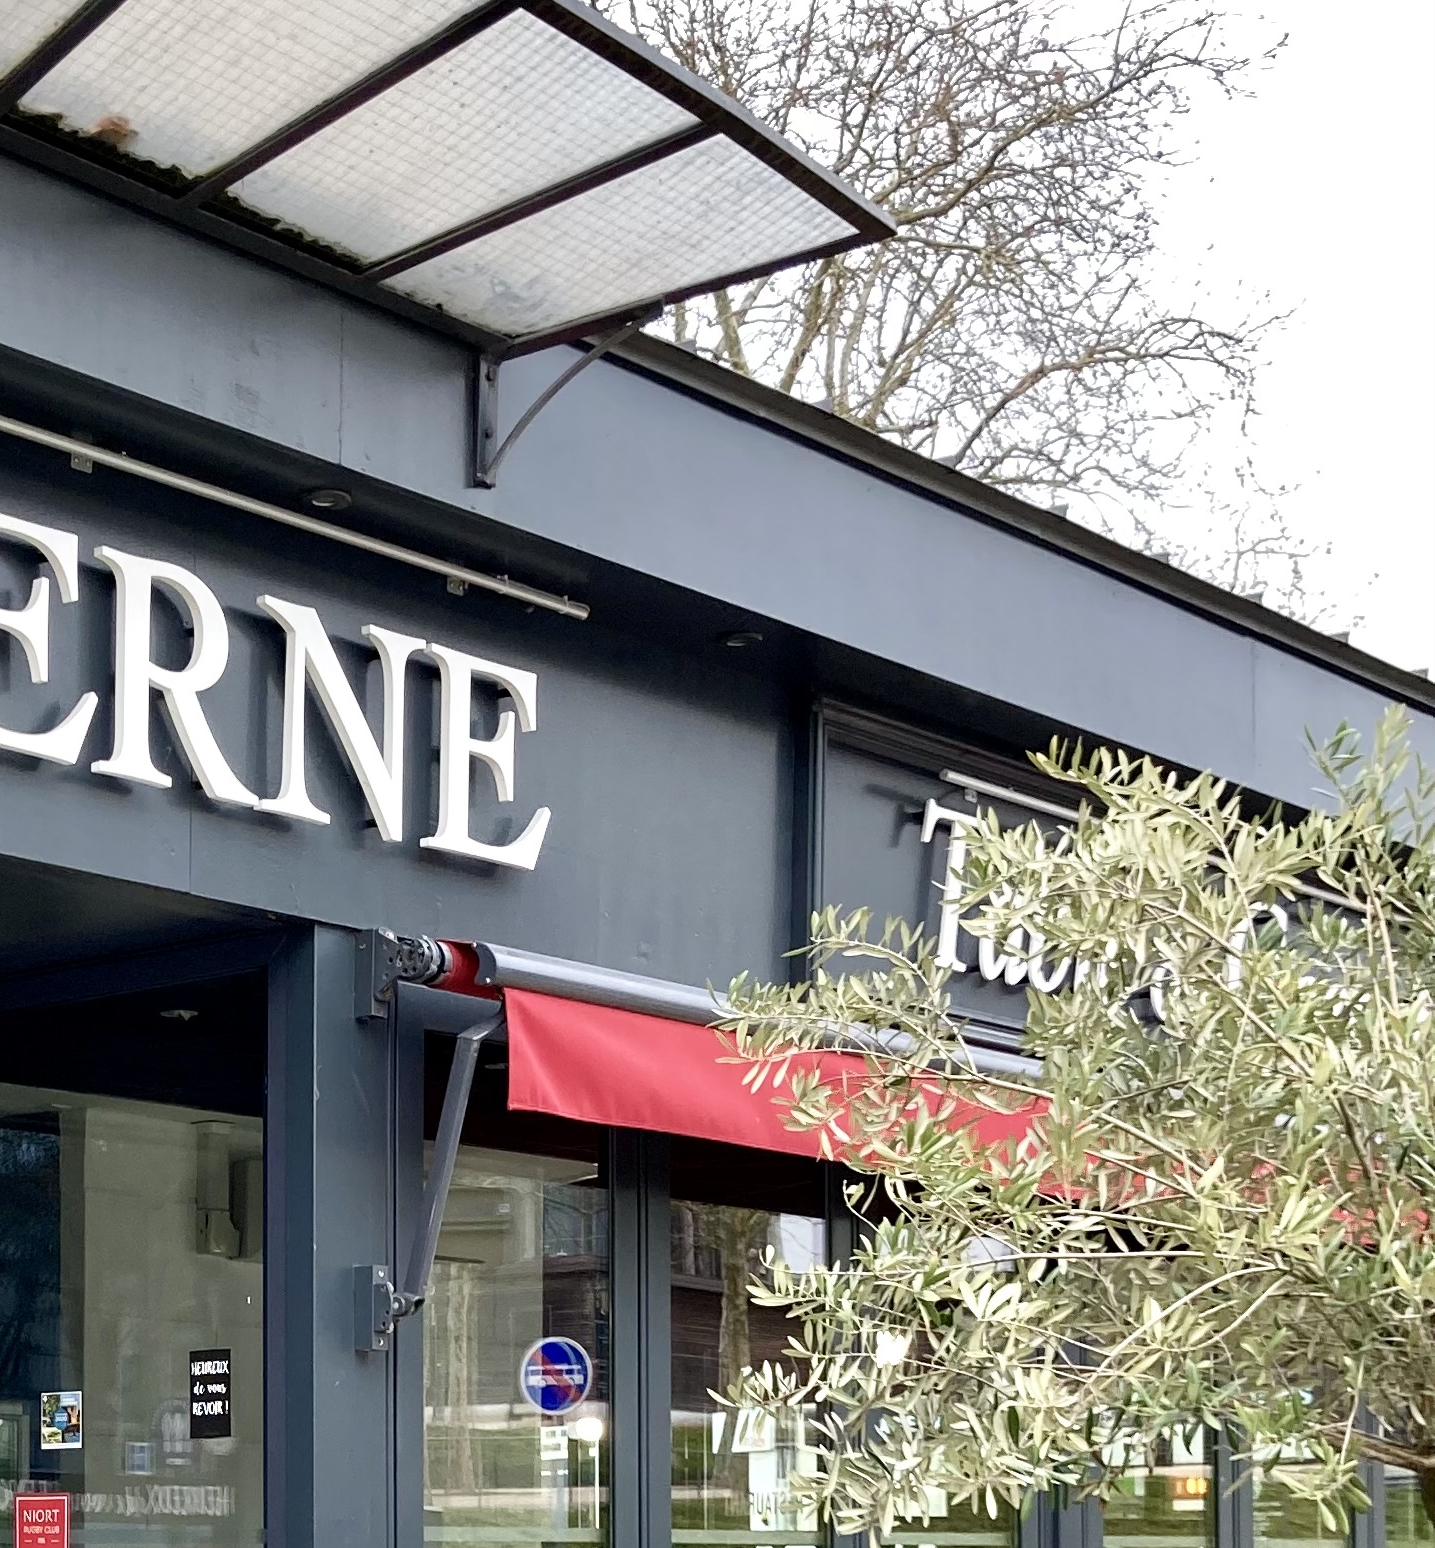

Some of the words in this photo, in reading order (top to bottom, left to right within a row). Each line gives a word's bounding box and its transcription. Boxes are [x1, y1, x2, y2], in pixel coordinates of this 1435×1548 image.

[191, 1360, 229, 1376] HEUREUX
[192, 1400, 224, 1416] REVOIR
[23, 1509, 60, 1523] NIORT
